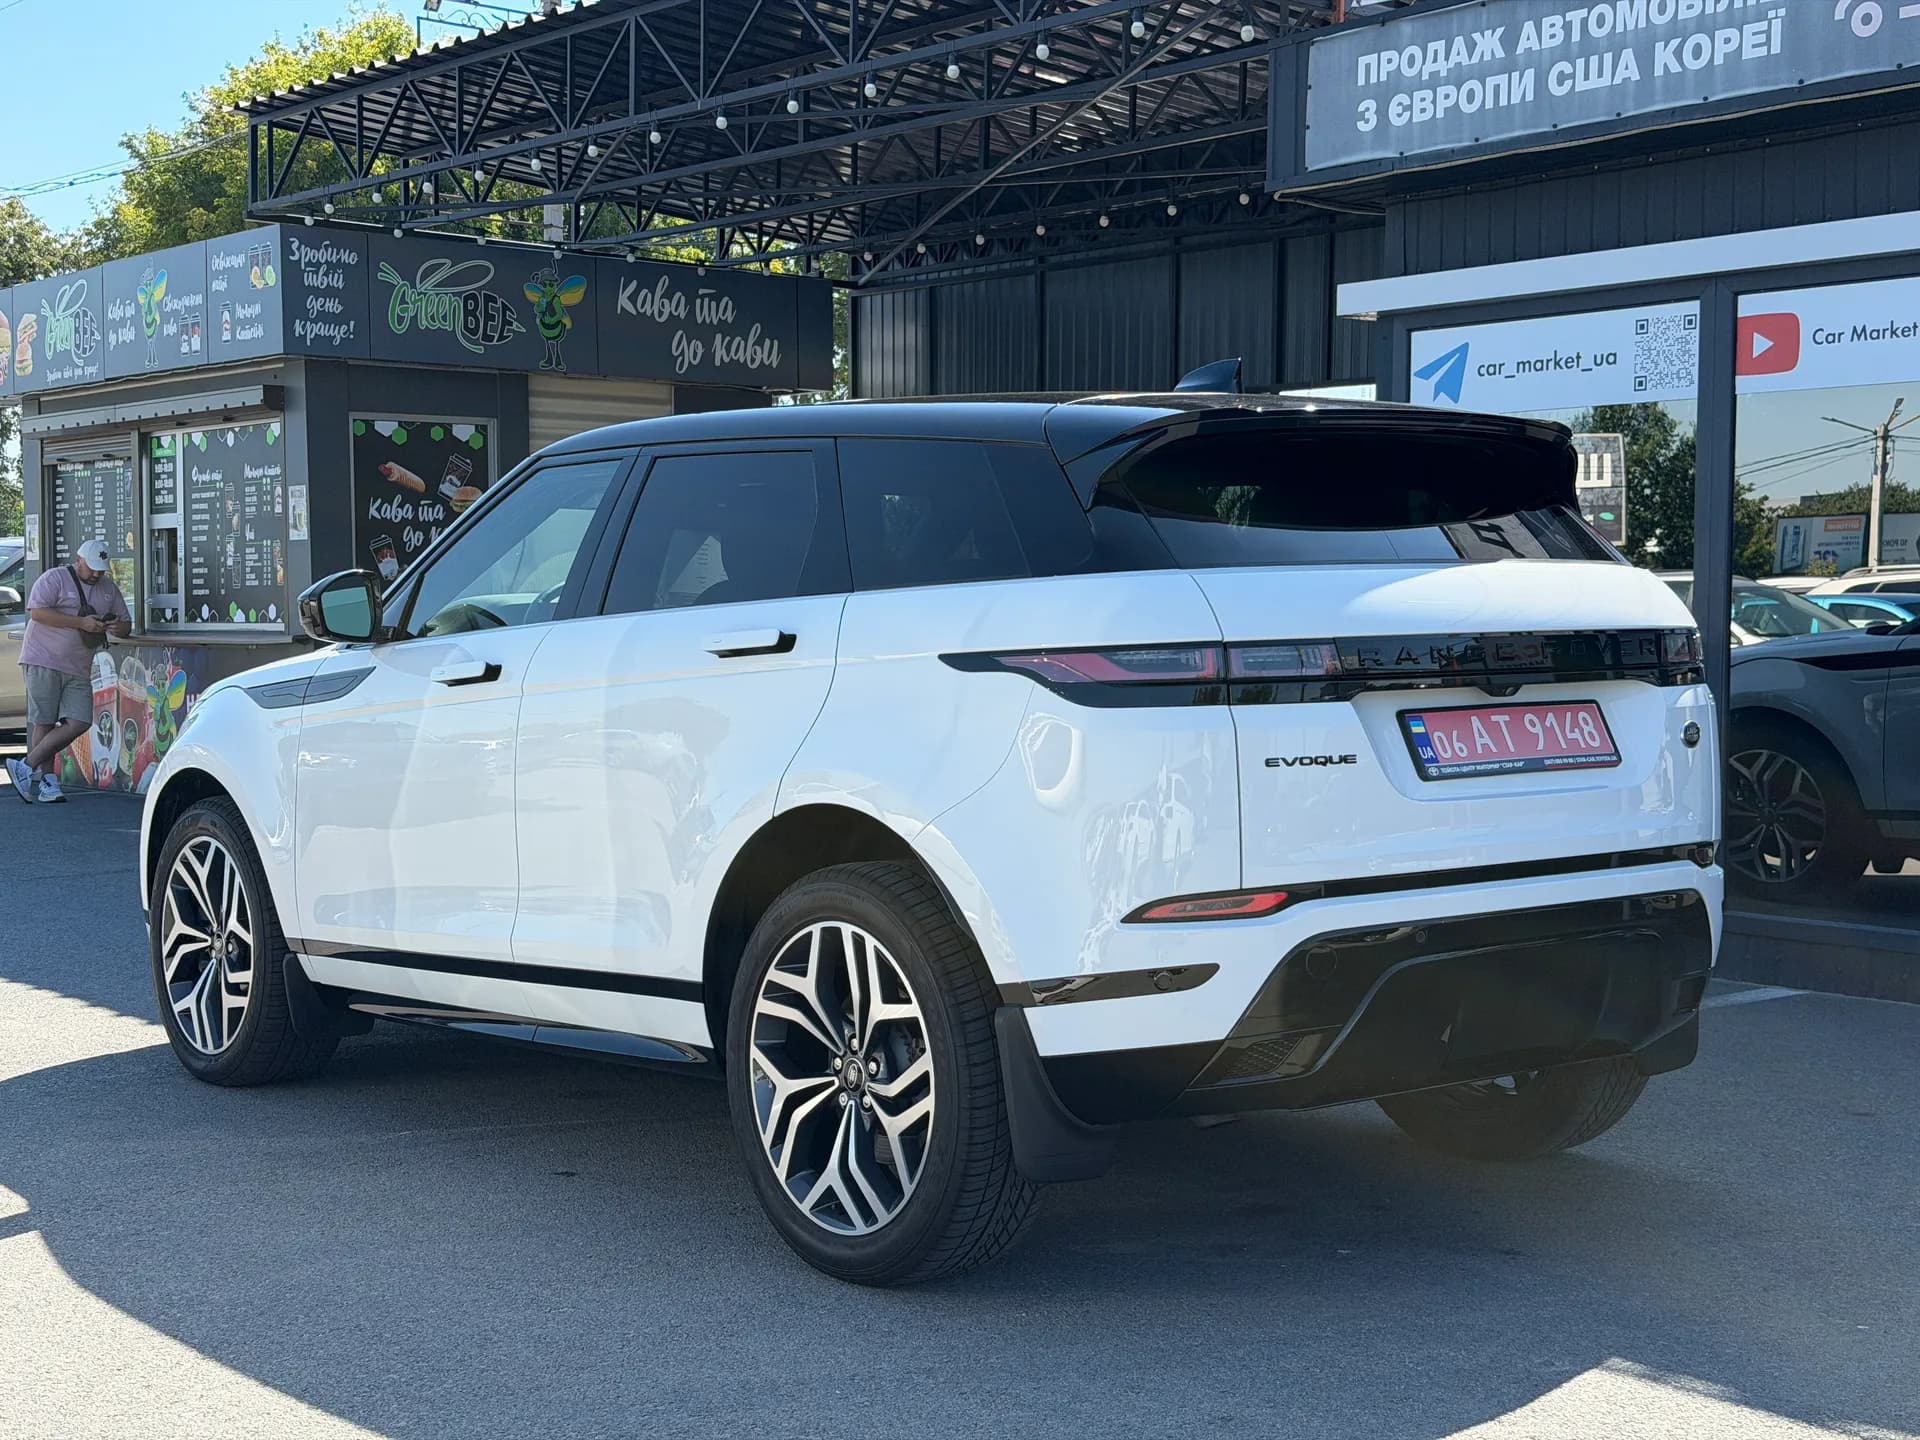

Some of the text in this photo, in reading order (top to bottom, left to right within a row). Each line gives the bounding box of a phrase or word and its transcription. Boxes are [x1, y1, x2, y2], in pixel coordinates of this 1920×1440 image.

[1356, 8, 1786, 132] З ЄВРОПИ США КОРЕЇ
[1357, 26, 1505, 87] ПРОДАЖ
[288, 238, 359, 270] Зробимо
[303, 264, 345, 290] твій
[306, 295, 344, 319] день
[617, 275, 736, 325] Кава та
[293, 319, 355, 347] краще!
[1812, 320, 1919, 345] Car Market
[671, 322, 781, 374] до кави
[1477, 350, 1618, 379] car_market_ua
[368, 494, 446, 523] Кава та
[403, 526, 424, 552] до
[1357, 637, 1657, 667] RANGE ROVER
[1419, 711, 1600, 760] UA 06 AT 9148
[1264, 754, 1358, 768] EVOQUE
